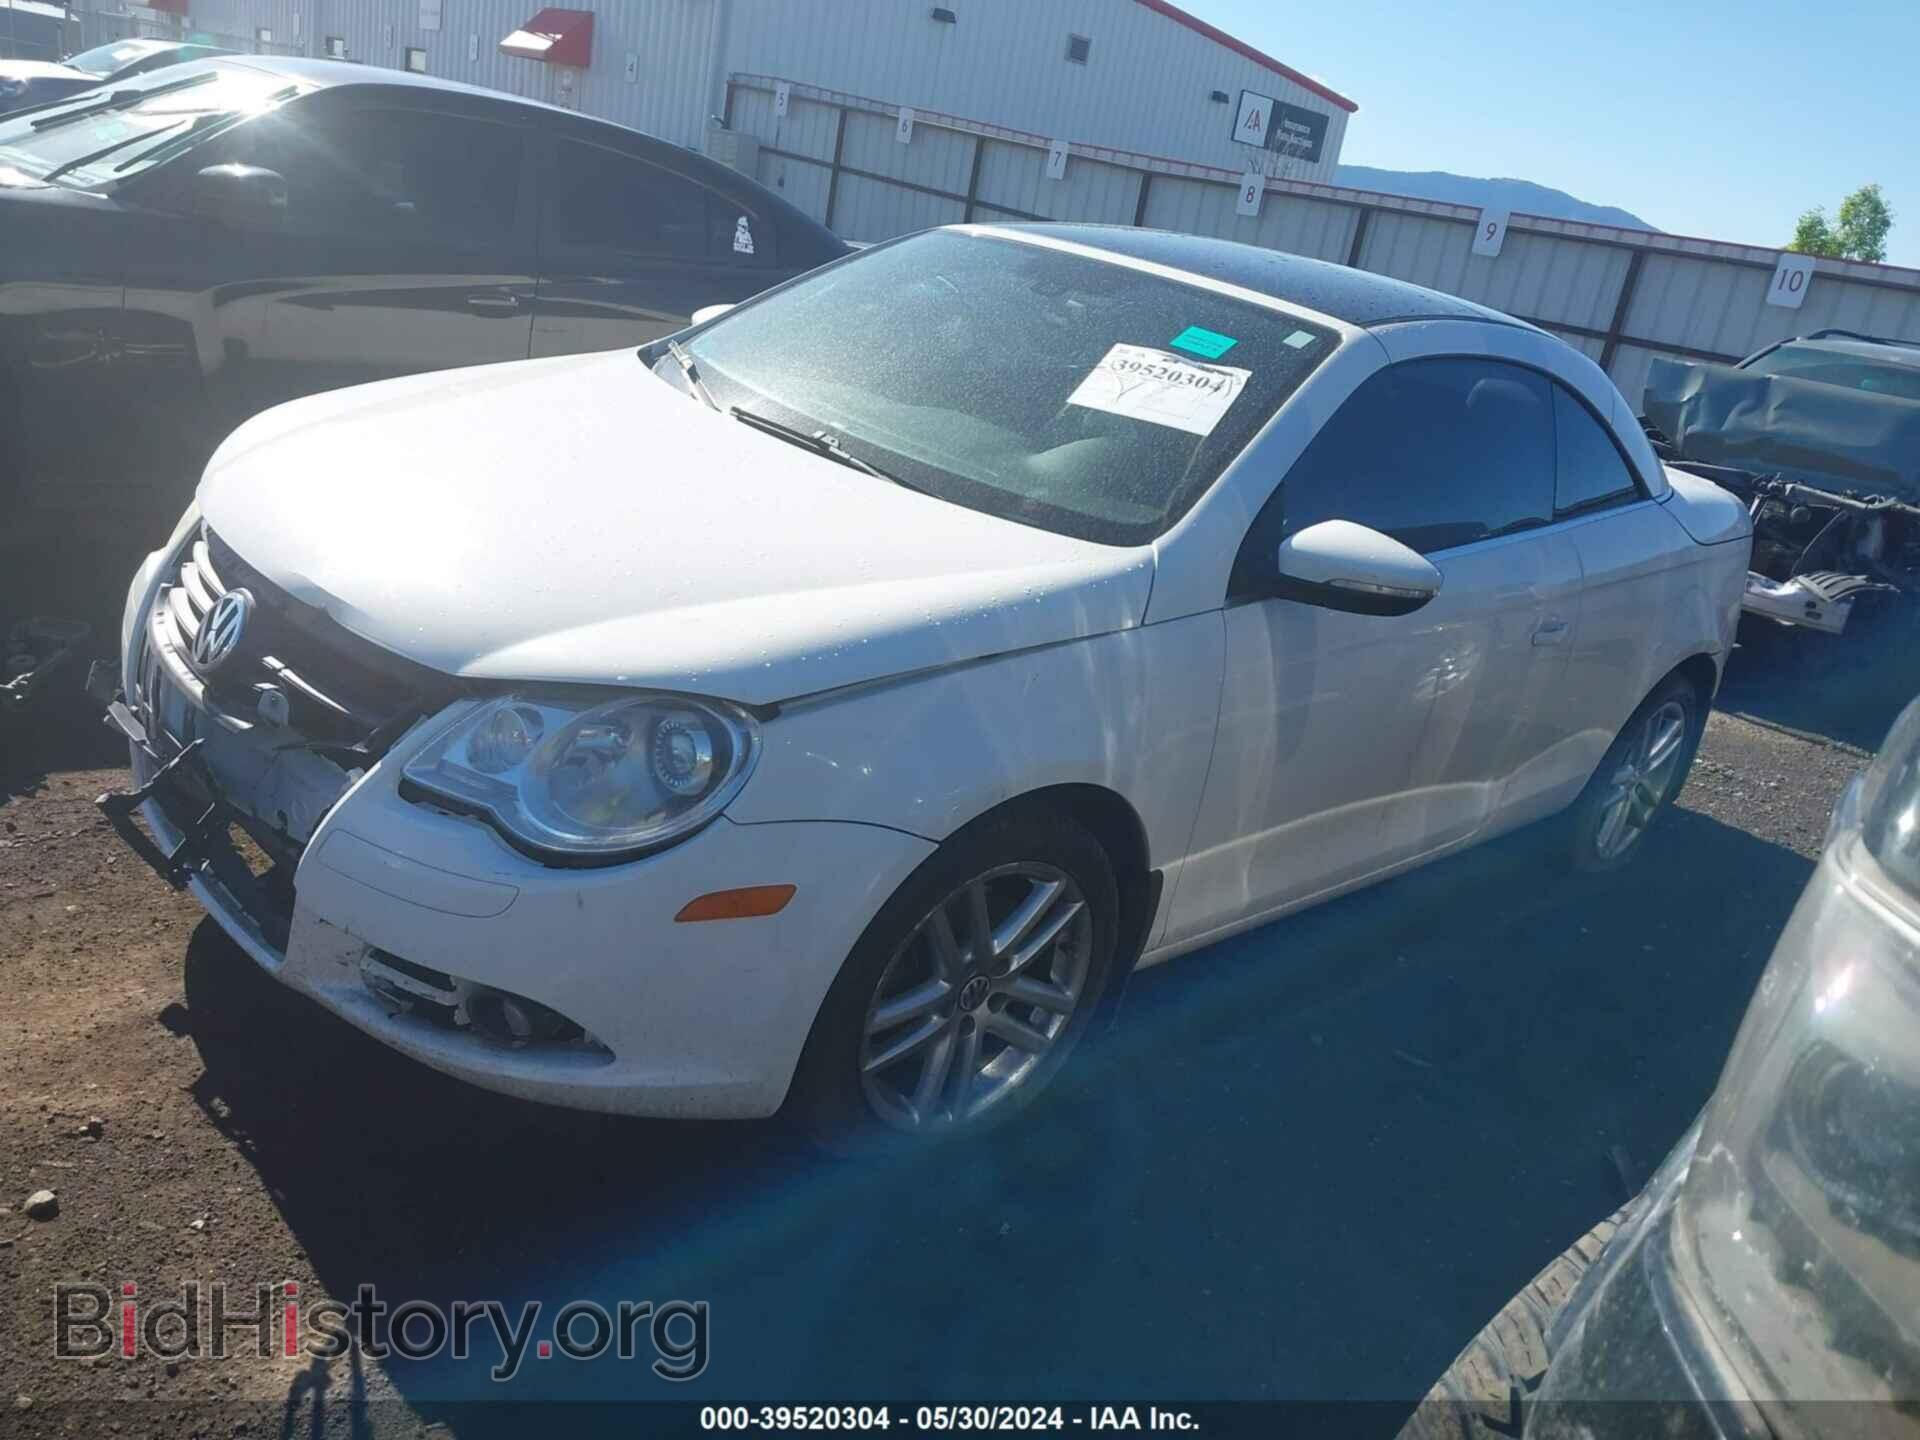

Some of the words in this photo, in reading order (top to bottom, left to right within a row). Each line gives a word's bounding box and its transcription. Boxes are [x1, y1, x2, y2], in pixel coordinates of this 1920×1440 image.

[901, 119, 909, 133] 6
[1054, 151, 1063, 168] 7
[1246, 184, 1256, 204] 8
[1486, 222, 1497, 241] 9
[1777, 268, 1805, 292] 10
[1116, 358, 1227, 394] 39520304
